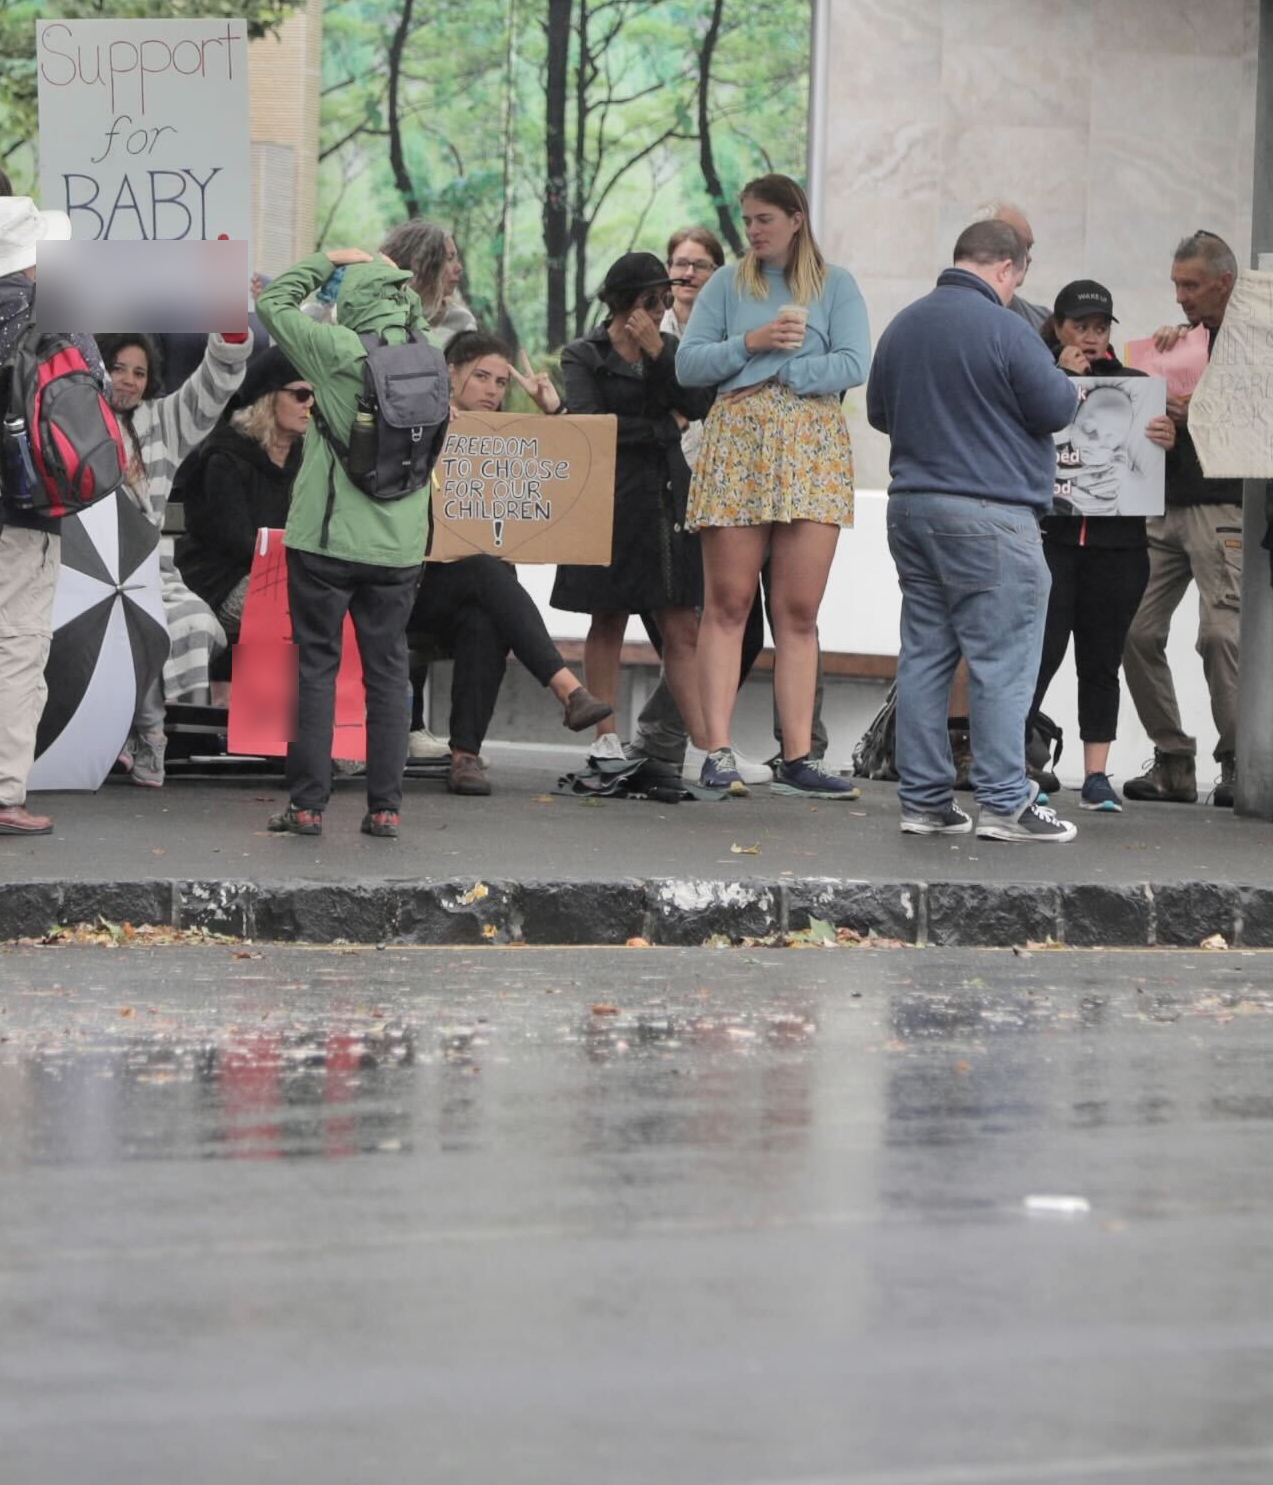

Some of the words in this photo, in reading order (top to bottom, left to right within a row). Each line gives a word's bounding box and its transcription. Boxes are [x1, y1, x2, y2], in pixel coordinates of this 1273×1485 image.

[41, 23, 241, 115] Support
[90, 115, 178, 164] for
[1077, 293, 1099, 301] WAKE
[444, 435, 538, 457] FREEDOM
[443, 458, 472, 478] TO
[444, 480, 483, 499] FOR
[493, 480, 541, 499] OUR
[1054, 480, 1071, 494] od
[444, 500, 551, 520] CHILDREN
[493, 521, 503, 546] !
